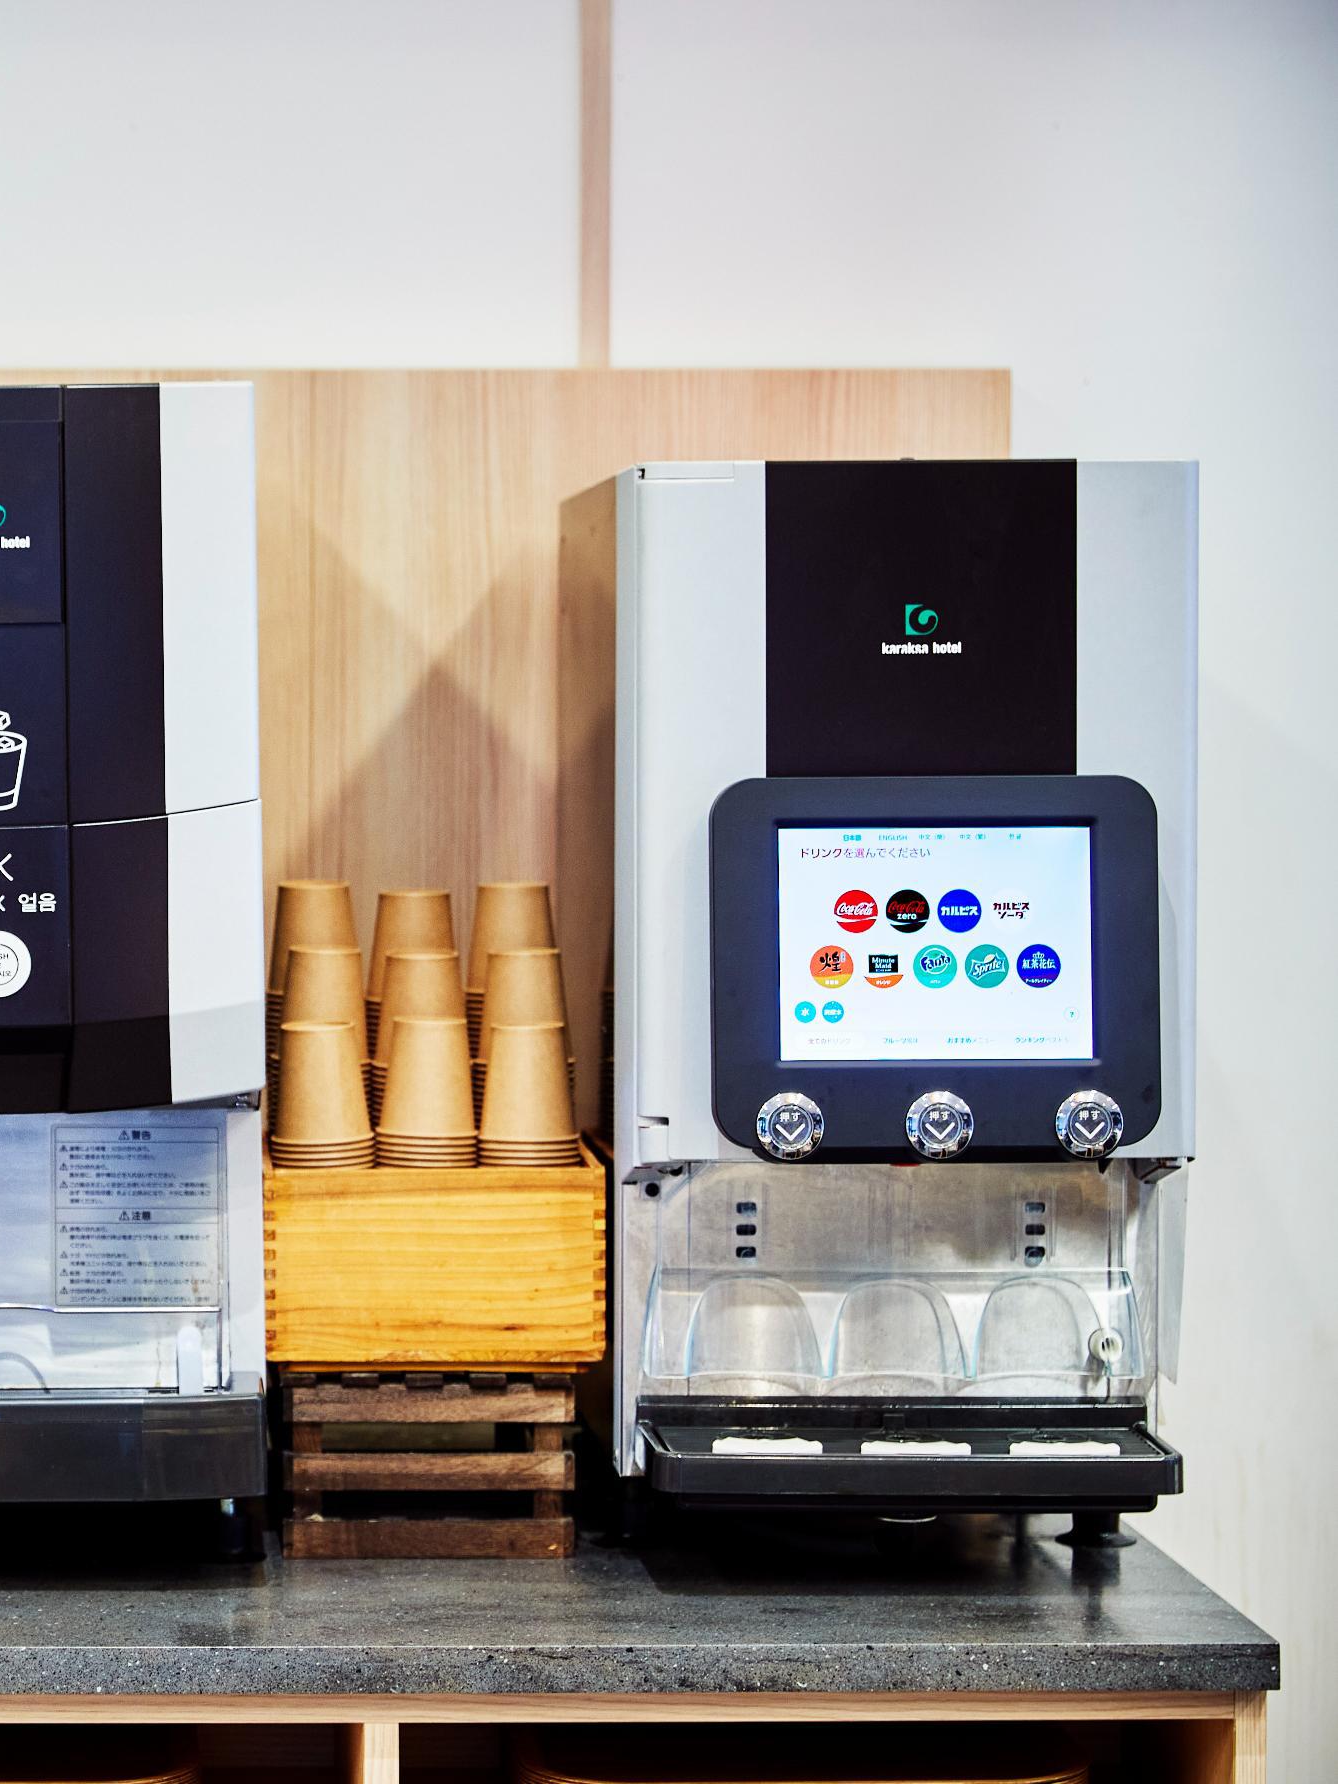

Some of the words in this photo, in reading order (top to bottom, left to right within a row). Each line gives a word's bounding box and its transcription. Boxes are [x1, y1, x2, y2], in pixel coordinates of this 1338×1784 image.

[0, 535, 31, 549] hotel
[881, 641, 929, 654] karaksa
[932, 640, 962, 654] hotel
[801, 847, 932, 859] ドリンクを選んでください
[17, 892, 57, 913] 얼음
[992, 902, 1030, 911] カルピス
[940, 905, 979, 916] カルピス
[997, 911, 1027, 920] ソーダ
[871, 956, 895, 964] Minute
[920, 954, 951, 972] Fanta
[972, 958, 1002, 976] Sprite
[779, 1111, 801, 1122] 押す
[929, 1110, 951, 1121] 押す
[1078, 1109, 1101, 1121] 押す
